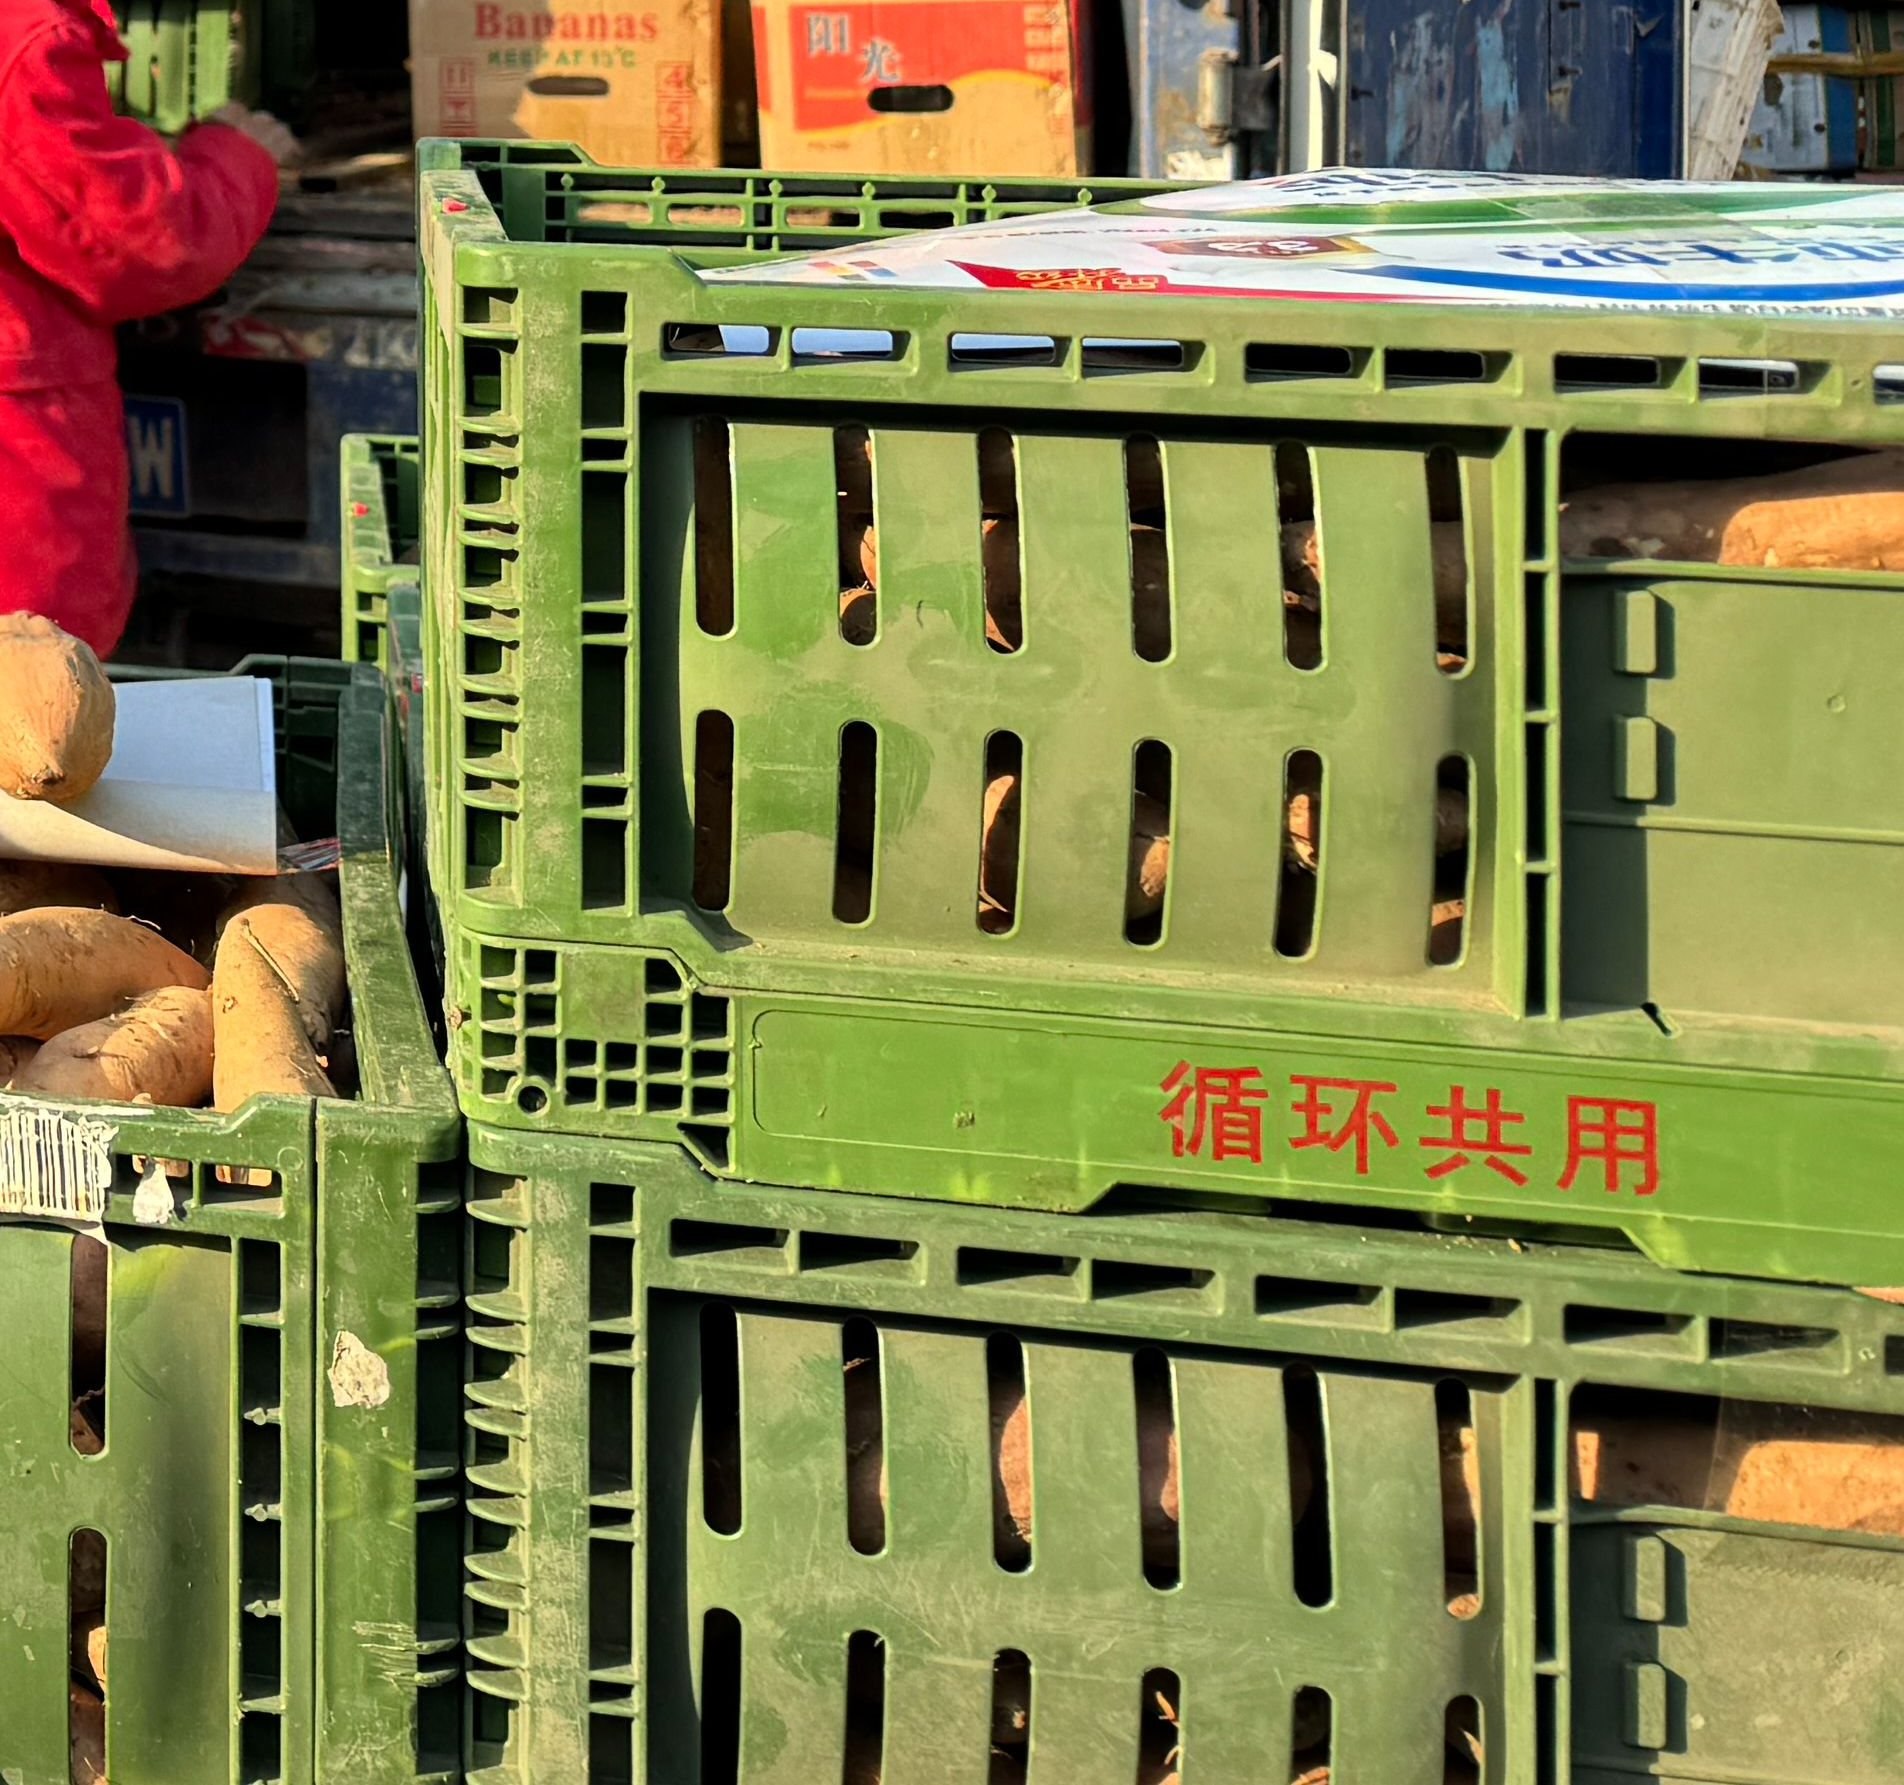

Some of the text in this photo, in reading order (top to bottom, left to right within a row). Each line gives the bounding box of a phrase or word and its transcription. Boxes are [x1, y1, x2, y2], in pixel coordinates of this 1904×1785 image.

[473, 1, 658, 42] Bananas
[806, 13, 901, 83] 阳光
[1158, 1060, 1659, 1196] 循环共用
